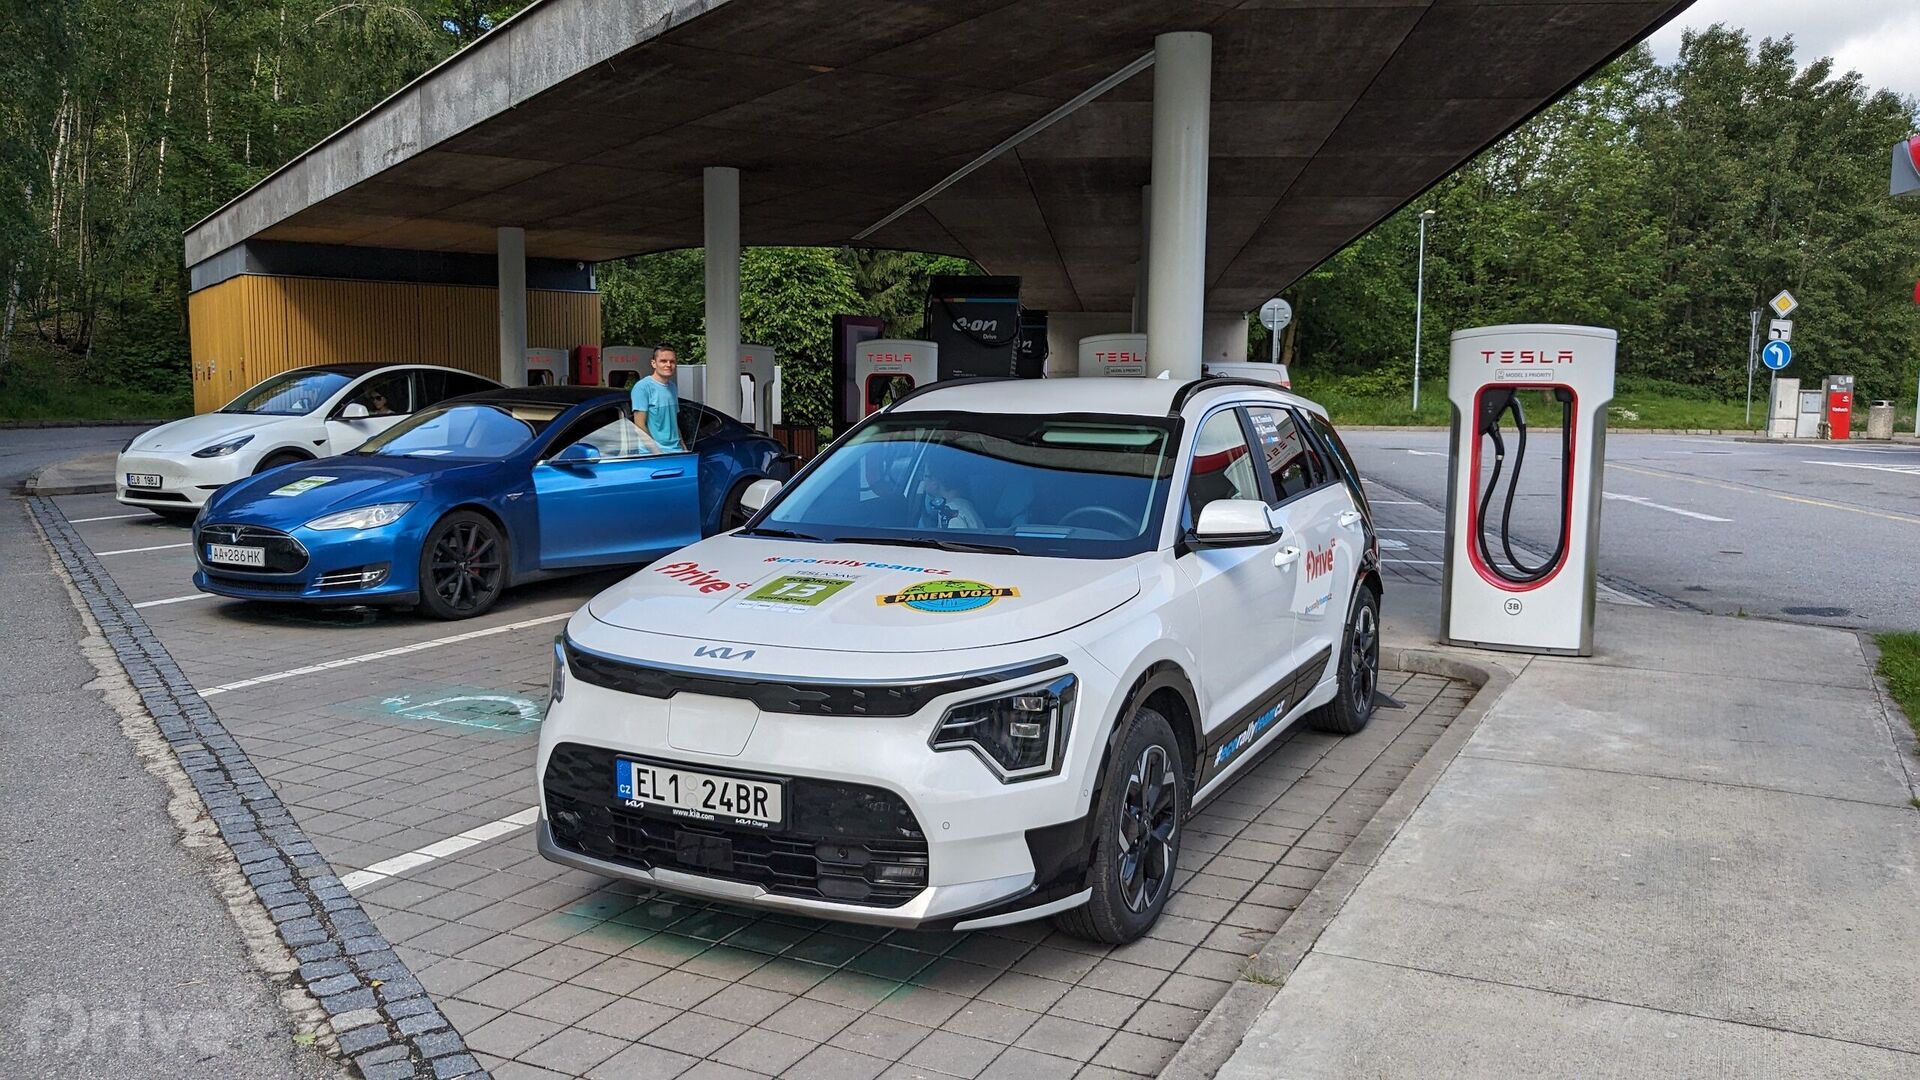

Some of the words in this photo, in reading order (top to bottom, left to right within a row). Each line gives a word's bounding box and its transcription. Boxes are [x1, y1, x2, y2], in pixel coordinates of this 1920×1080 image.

[867, 353, 912, 362] TESLA
[1096, 352, 1147, 362] TESL
[1481, 351, 1573, 363] TESLA
[214, 547, 225, 560] AA
[763, 556, 952, 576] #ecorallyteamcz
[771, 582, 828, 598] 13
[894, 590, 954, 603] PANEM
[959, 588, 1003, 598] VOZU
[693, 645, 756, 661] KIA
[620, 784, 631, 795] CZ
[637, 767, 679, 804] EL1
[702, 778, 769, 818] 24BR
[625, 799, 645, 809] KIA
[672, 808, 715, 821] www.kia.com
[752, 820, 769, 828] Charge
